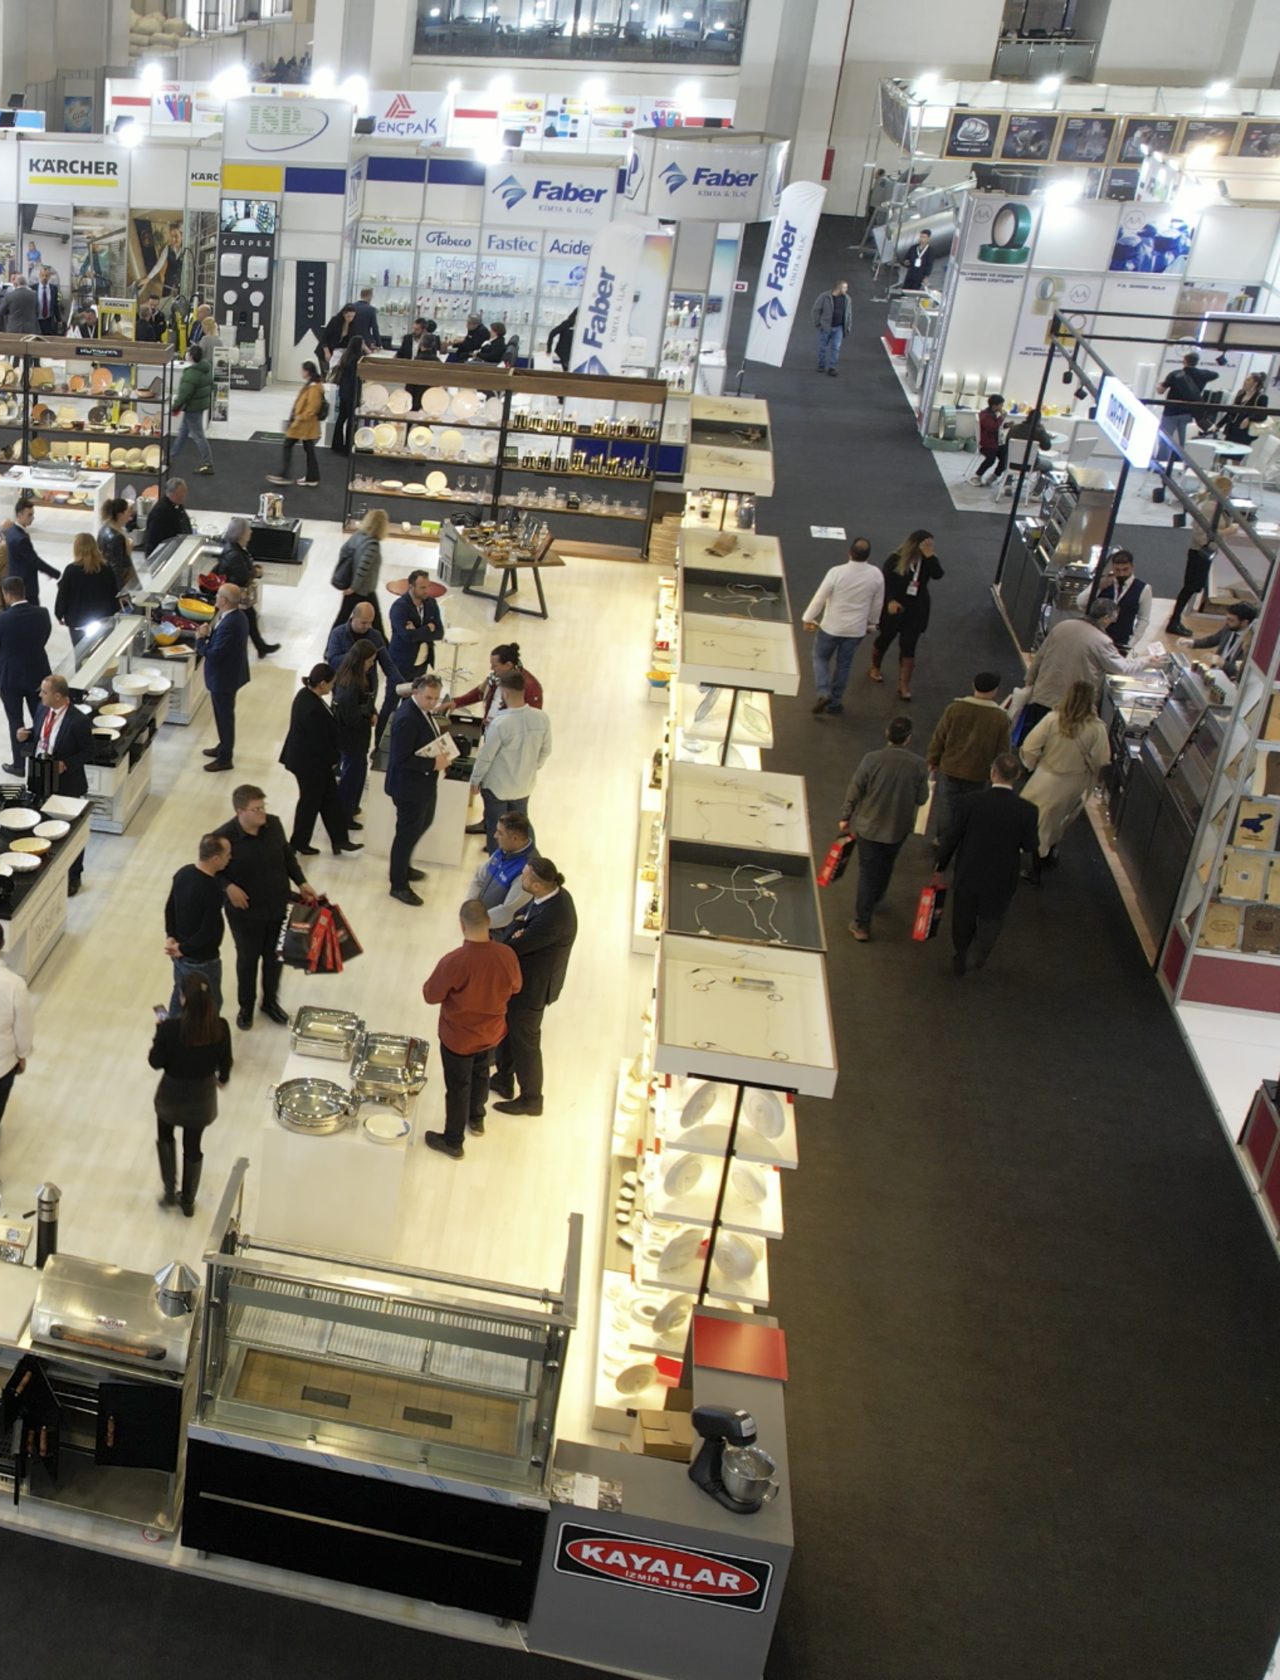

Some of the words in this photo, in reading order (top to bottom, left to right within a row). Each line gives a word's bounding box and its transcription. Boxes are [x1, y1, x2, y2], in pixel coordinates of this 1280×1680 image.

[371, 117, 437, 136] ENÇPAK
[29, 158, 119, 175] KÄRCHER
[692, 167, 759, 187] Faber
[532, 180, 608, 203] Faber
[222, 239, 271, 247] CARPEX
[361, 234, 412, 246] Naturex
[766, 220, 797, 291] Faber
[582, 265, 615, 349] Faber
[580, 1544, 741, 1591] KAYALAR
[624, 1570, 661, 1585] İZMİR
[665, 1579, 693, 1591] 1986
